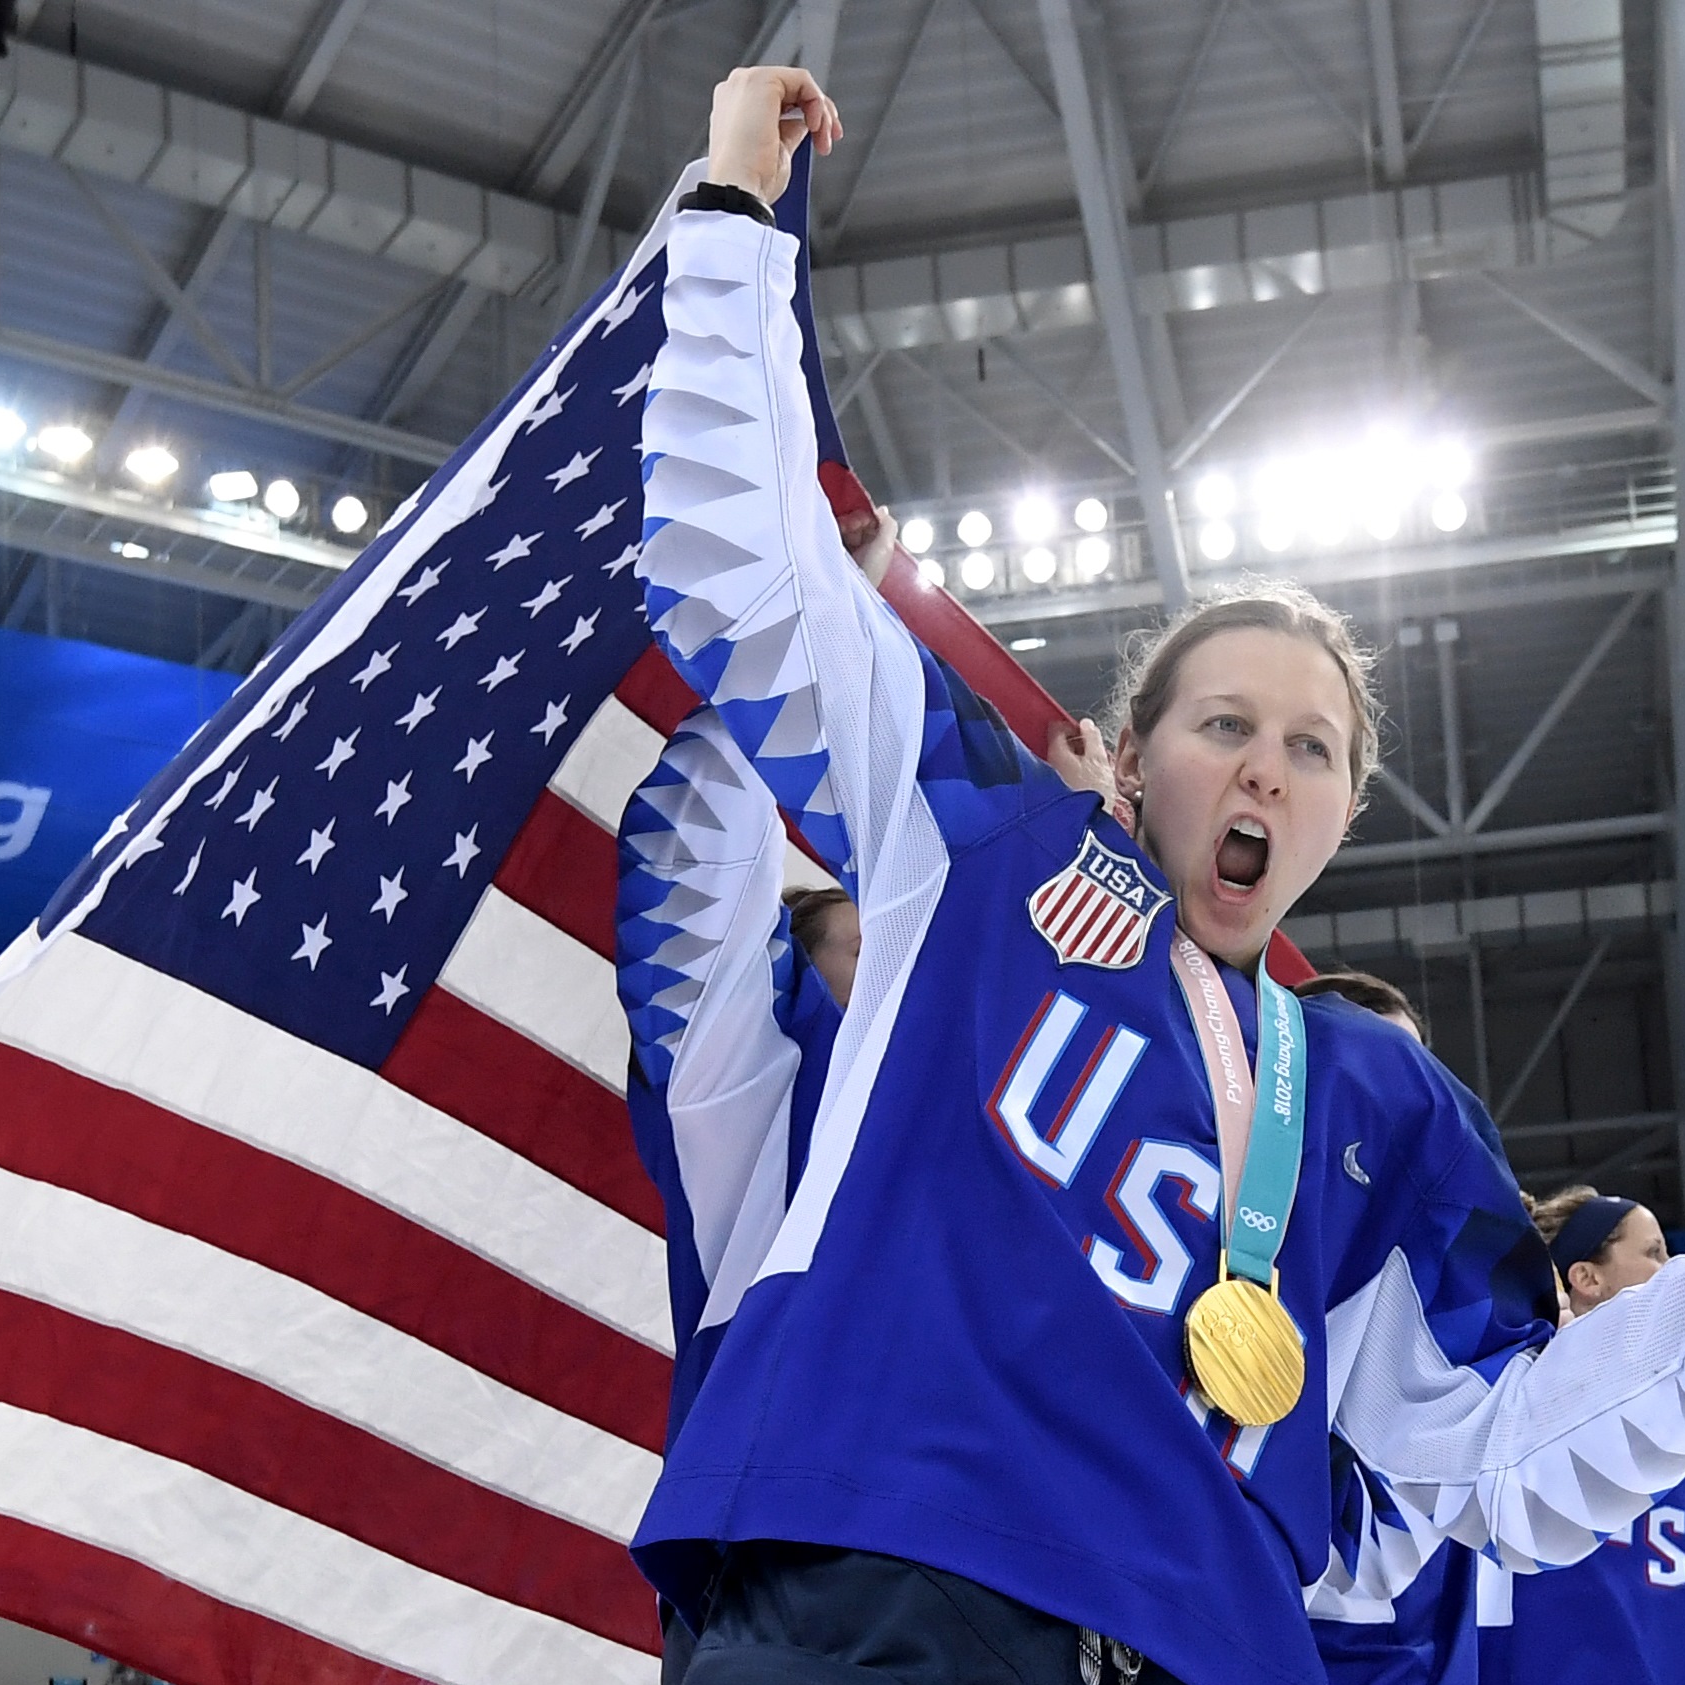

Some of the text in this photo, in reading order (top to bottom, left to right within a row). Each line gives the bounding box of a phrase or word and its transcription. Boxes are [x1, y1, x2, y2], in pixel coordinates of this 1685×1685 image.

[1089, 853, 1145, 907] USA
[1178, 938, 1242, 1105] PyeongChang 2018
